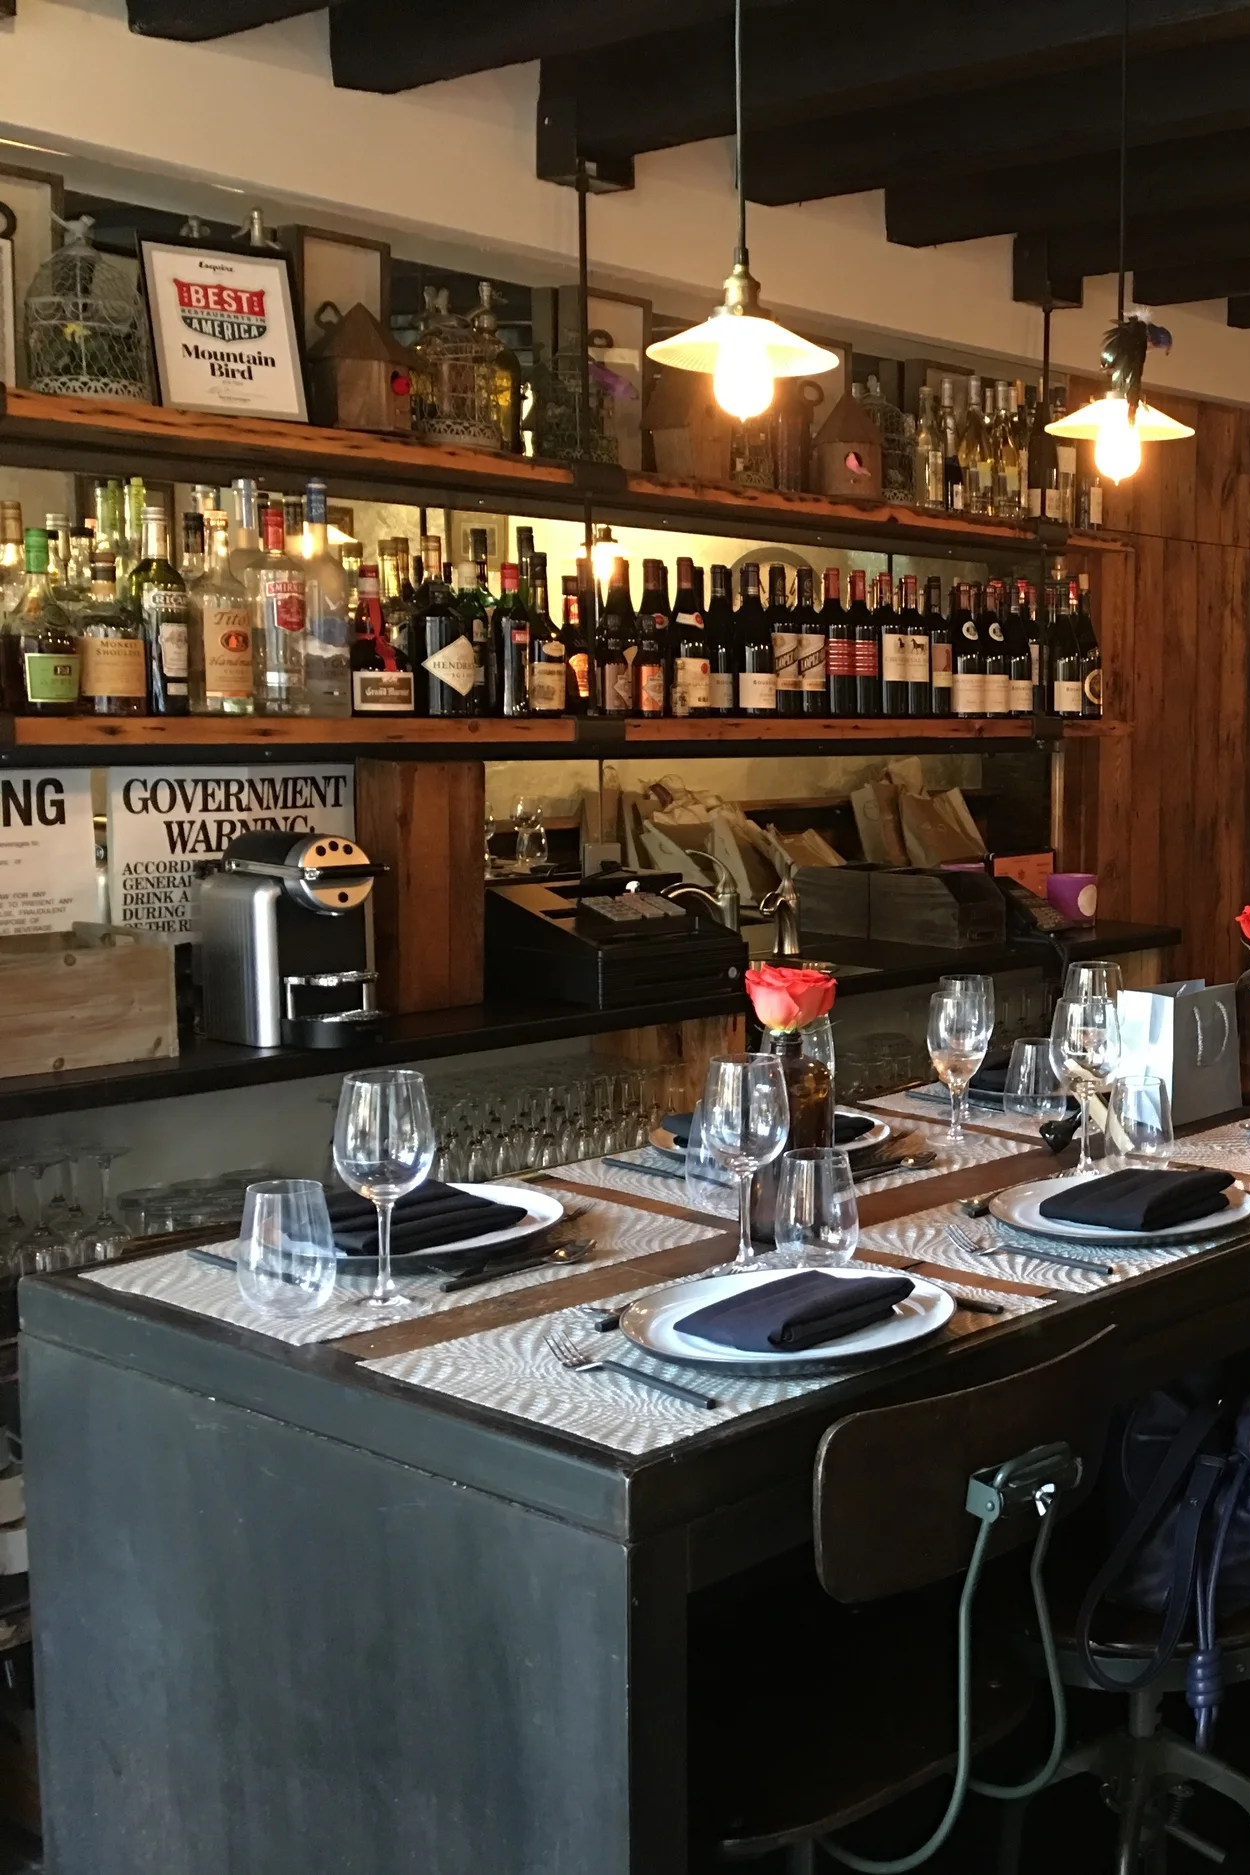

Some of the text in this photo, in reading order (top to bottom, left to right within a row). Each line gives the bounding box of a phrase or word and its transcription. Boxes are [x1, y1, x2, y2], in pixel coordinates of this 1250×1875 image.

[190, 285, 250, 313] BEST
[181, 308, 252, 322] RESTAURANTS
[191, 318, 259, 341] AMERICA
[181, 343, 276, 368] Mountain
[209, 362, 254, 381] Bird
[122, 775, 348, 815] GOVERNMENT
[122, 860, 196, 876] ACCORD
[122, 891, 174, 906] DRINK
[122, 904, 187, 922] DURING
